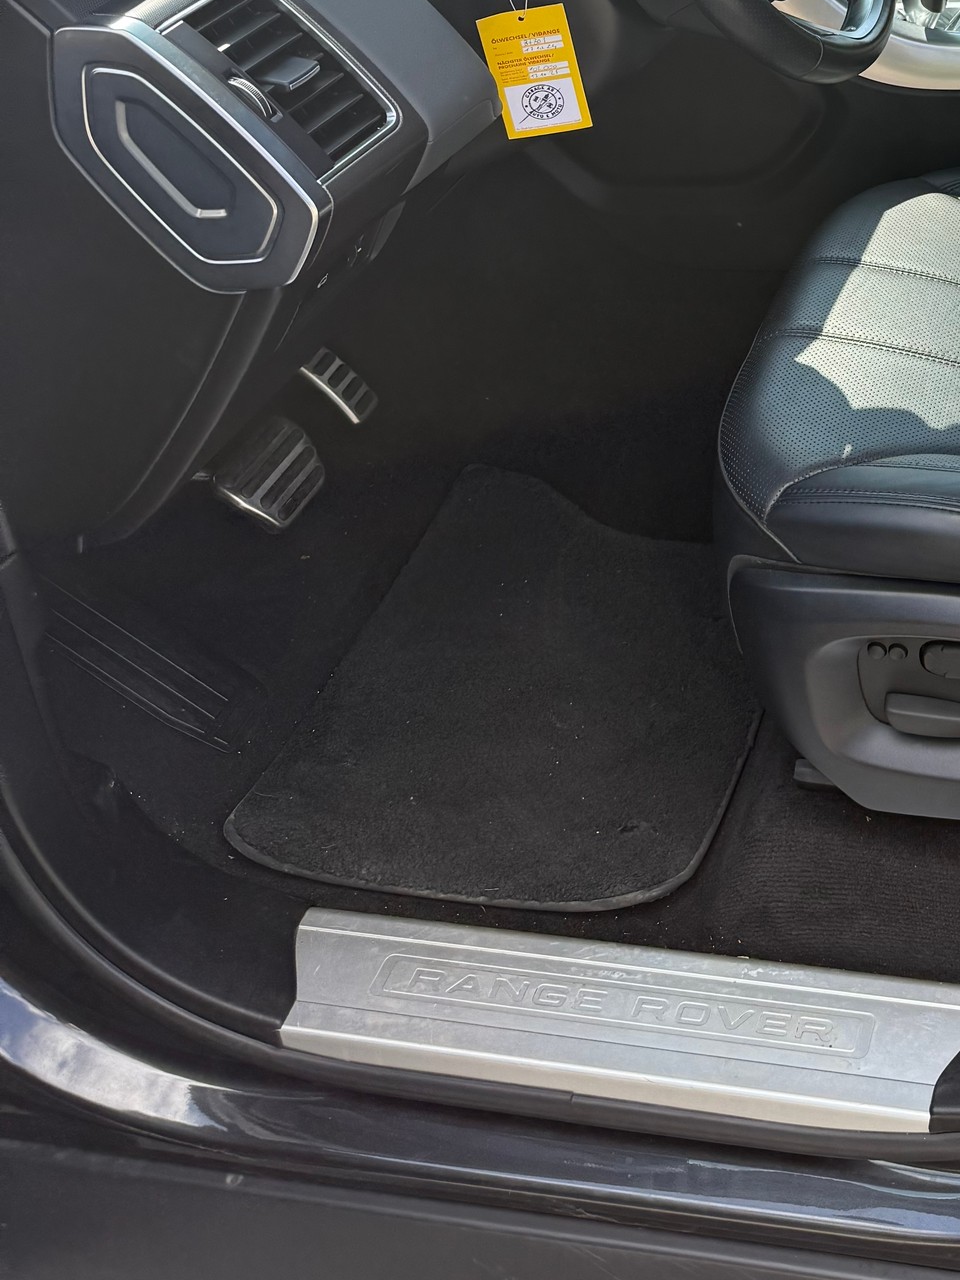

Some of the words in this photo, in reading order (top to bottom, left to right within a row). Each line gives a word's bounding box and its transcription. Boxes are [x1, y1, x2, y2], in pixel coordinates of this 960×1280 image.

[528, 58, 550, 66] VIDANGE
[525, 85, 544, 98] GARAGE
[407, 966, 609, 1013] RANGE
[630, 995, 836, 1043] ROVER
